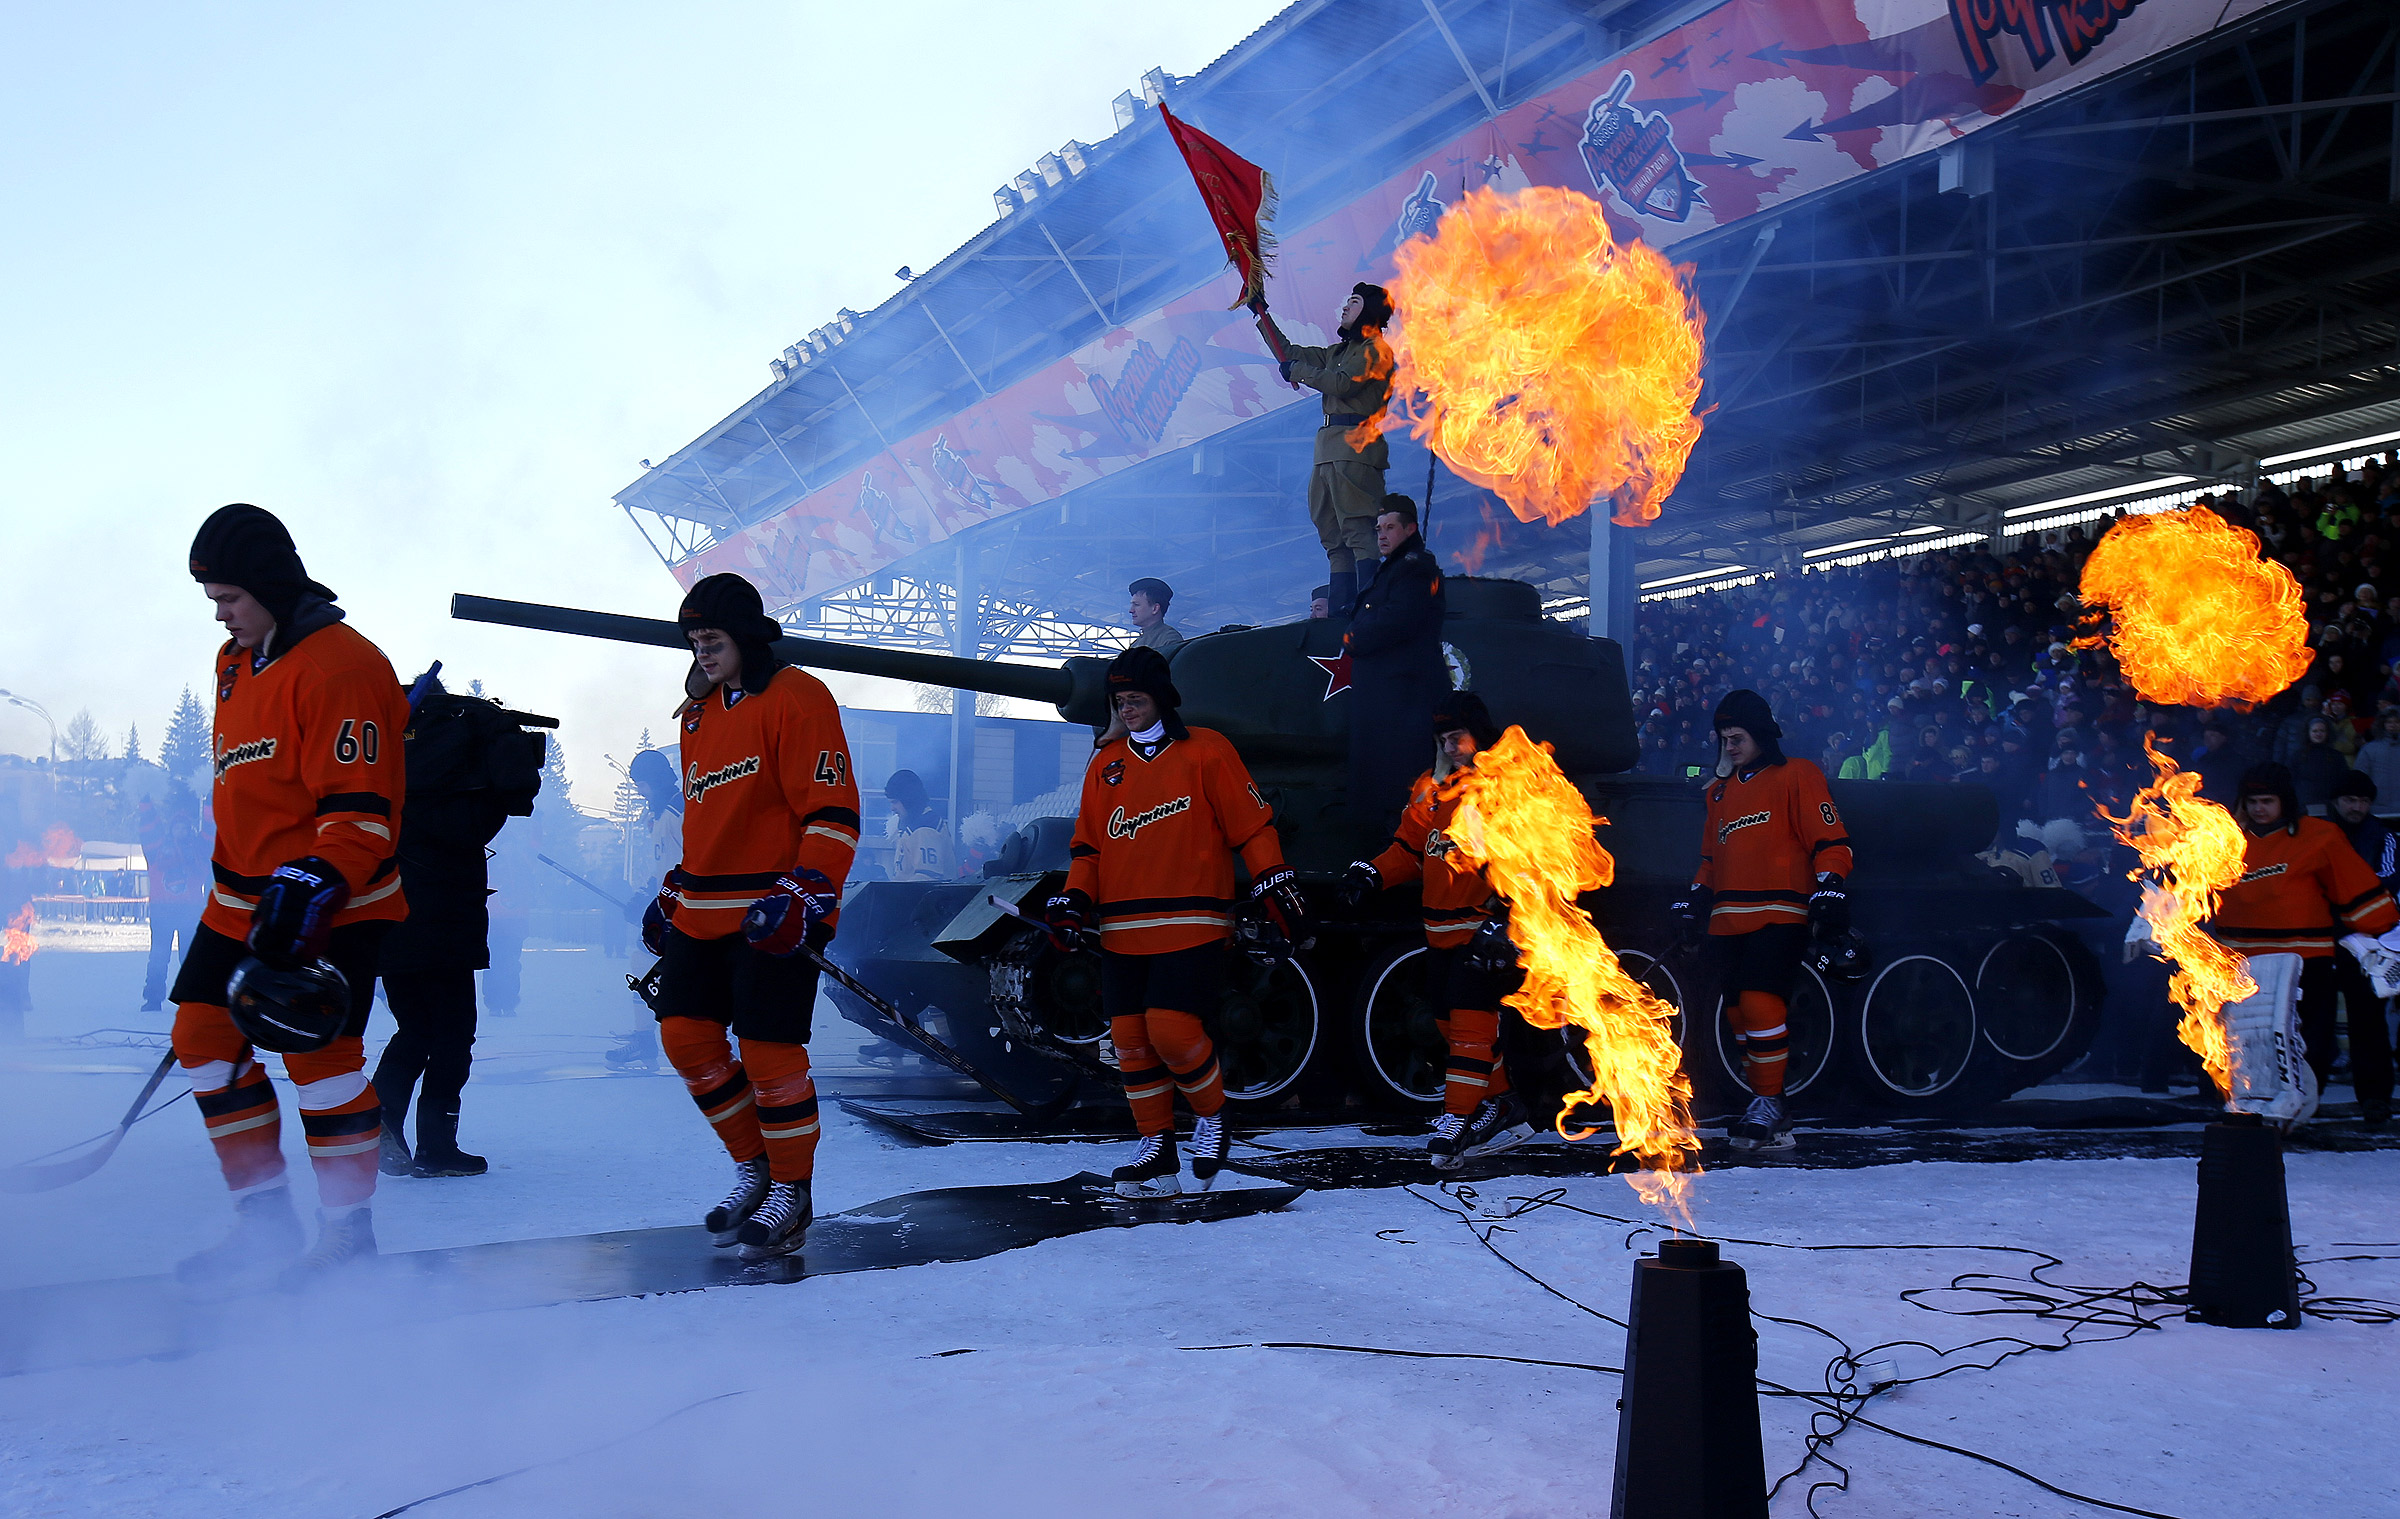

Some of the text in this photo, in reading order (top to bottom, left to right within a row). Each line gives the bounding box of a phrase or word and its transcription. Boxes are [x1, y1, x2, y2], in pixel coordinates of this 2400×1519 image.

[334, 719, 379, 764] 60
[684, 755, 760, 803] Спутник
[814, 751, 847, 786] 49
[1107, 796, 1191, 839] Спутник
[920, 848, 937, 865] 16
